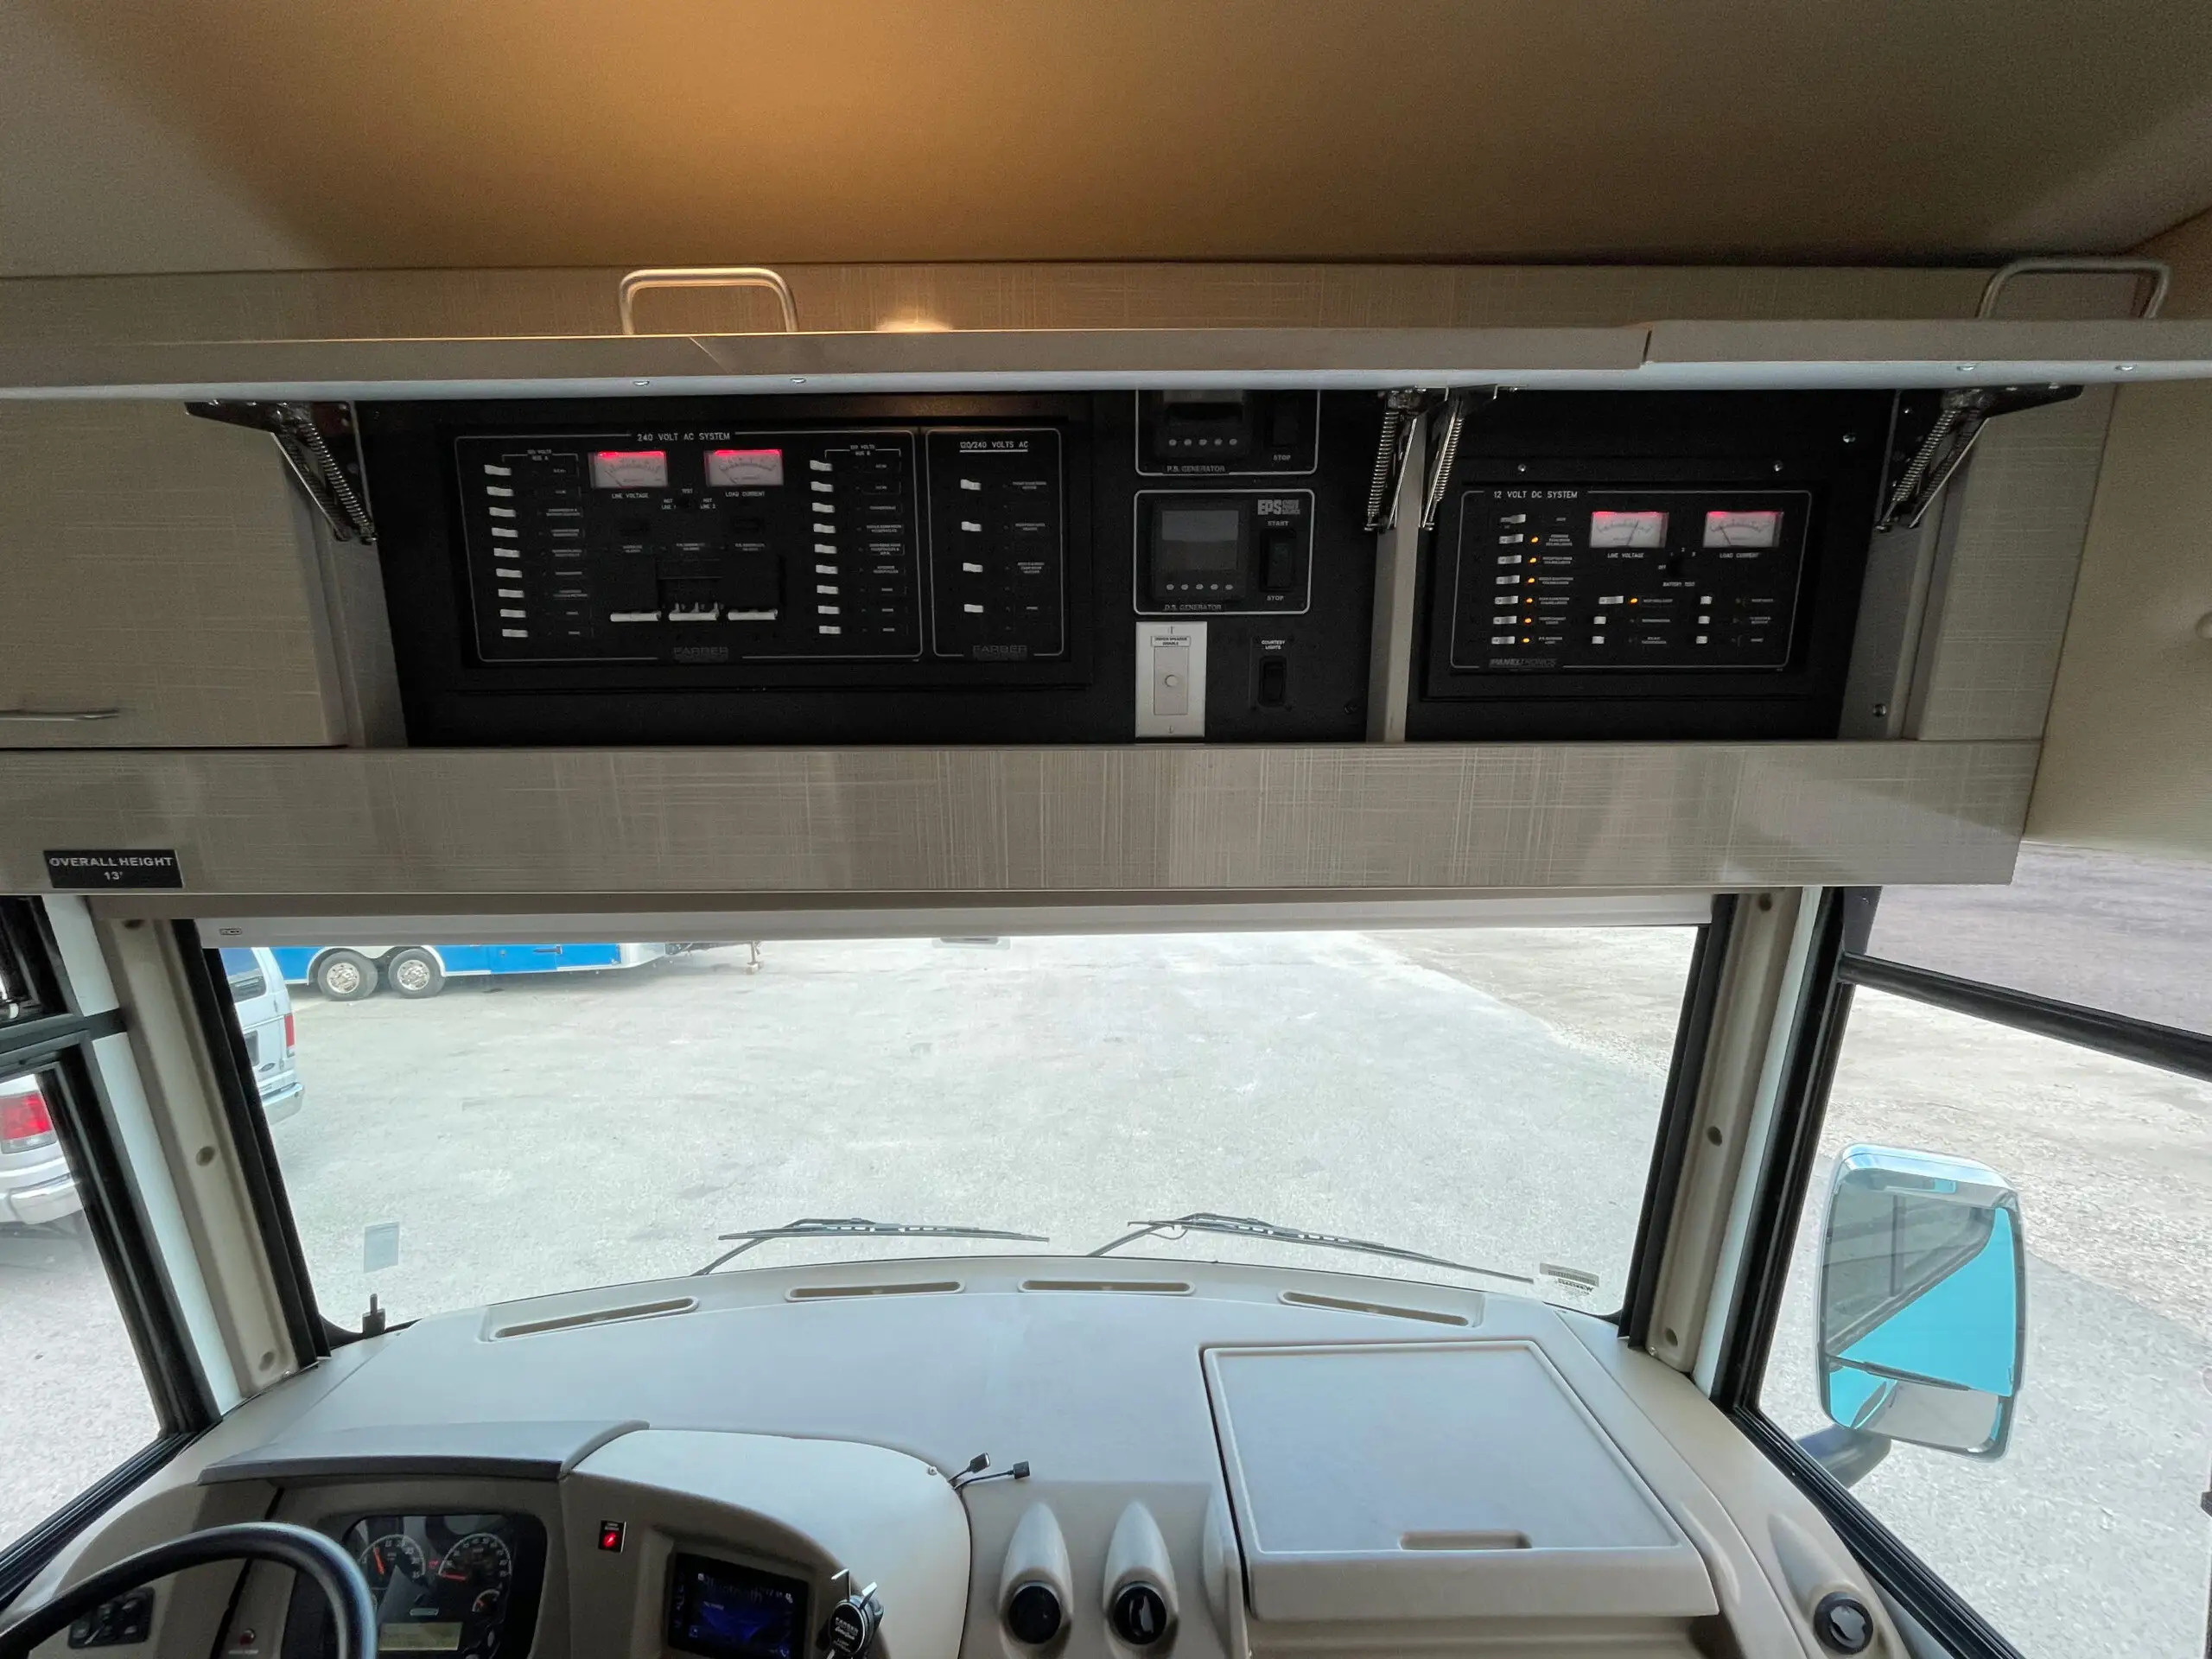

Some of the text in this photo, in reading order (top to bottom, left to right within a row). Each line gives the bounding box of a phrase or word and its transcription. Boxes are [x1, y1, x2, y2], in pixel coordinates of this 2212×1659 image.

[638, 433, 654, 442] 240
[699, 432, 731, 441] SYSTEM
[49, 857, 174, 867] OVERALL HEIGHT
[105, 871, 123, 880] 13'
